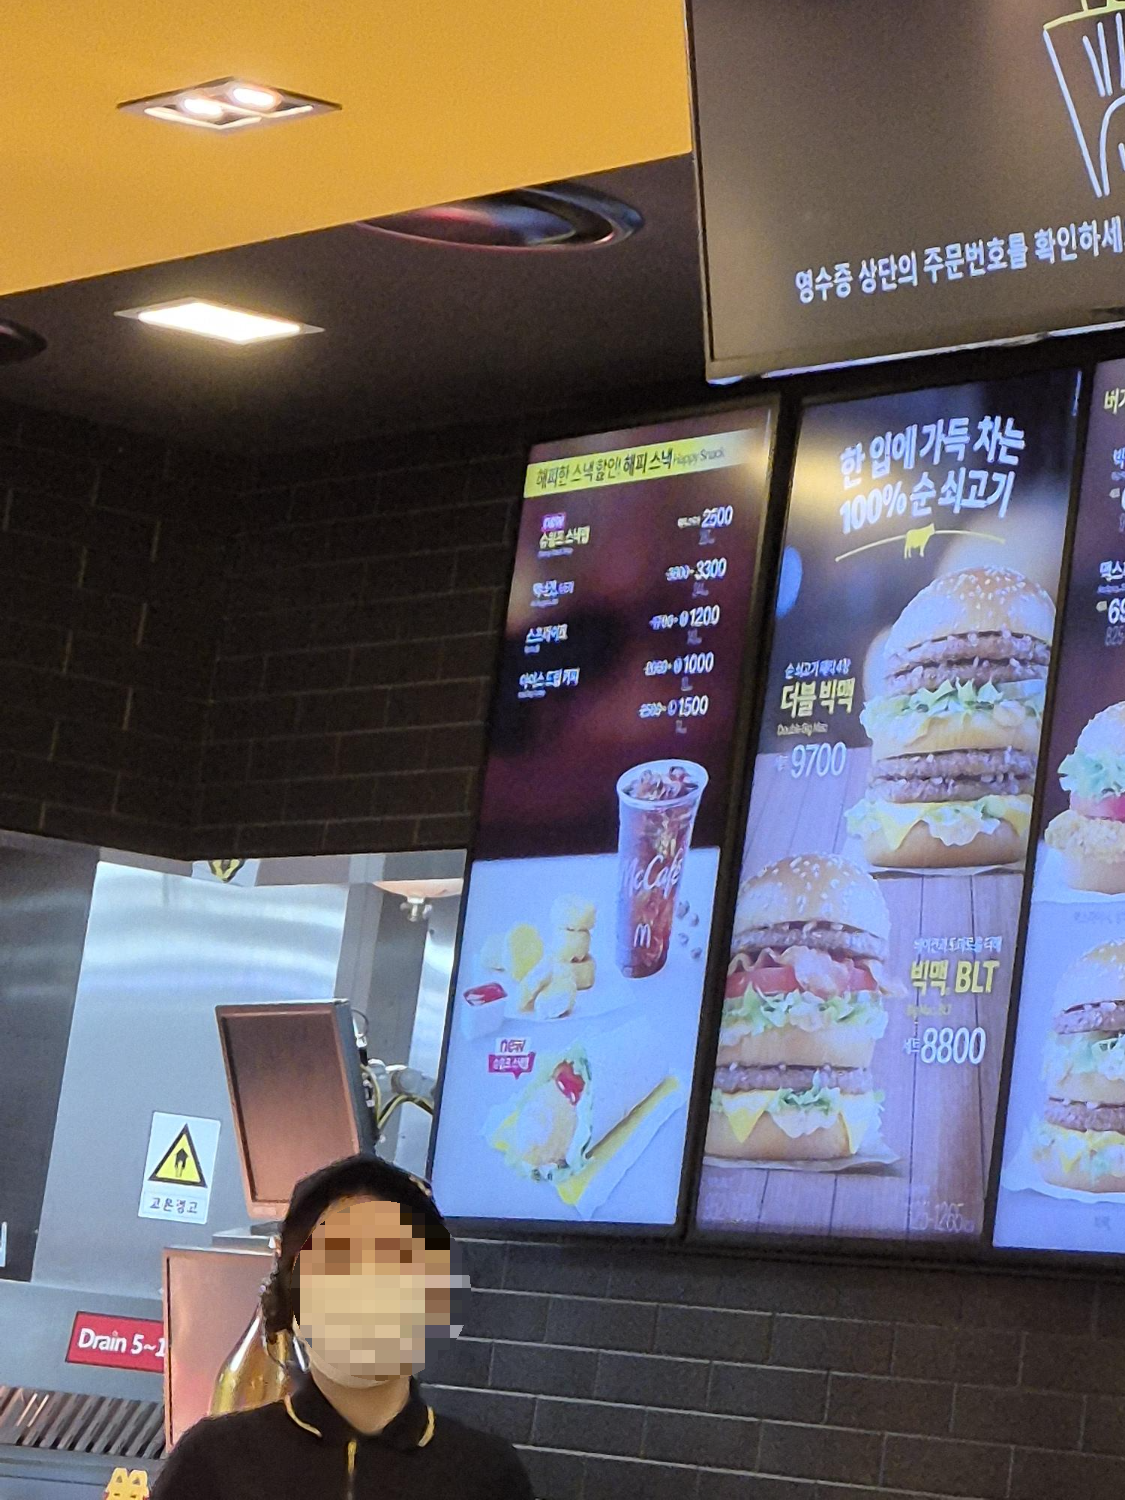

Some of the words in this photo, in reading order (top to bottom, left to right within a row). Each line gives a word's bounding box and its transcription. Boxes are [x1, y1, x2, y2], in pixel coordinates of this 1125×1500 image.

[795, 263, 854, 304] 영수증
[858, 250, 919, 295] 상단의
[923, 232, 1029, 283] 주문번호를
[623, 451, 648, 476] 해피
[648, 447, 673, 471] 스낵
[840, 442, 866, 491] 한
[869, 424, 917, 479] 입에
[919, 417, 971, 465] 가득
[973, 415, 1026, 466] 차는
[701, 505, 733, 528] 2500
[840, 480, 907, 535] 100%
[910, 471, 936, 518] 순
[938, 467, 1016, 518] 쇠고기
[690, 605, 720, 627] 1200
[684, 651, 715, 675] 1000
[679, 695, 709, 717] 1500
[781, 680, 817, 718] 더블
[819, 677, 856, 715] 빅맥
[791, 741, 847, 778] 9700
[911, 959, 949, 996] 빅맥
[955, 960, 1000, 993] BLT
[921, 1026, 987, 1065] 8800
[78, 1328, 127, 1354] Drain
